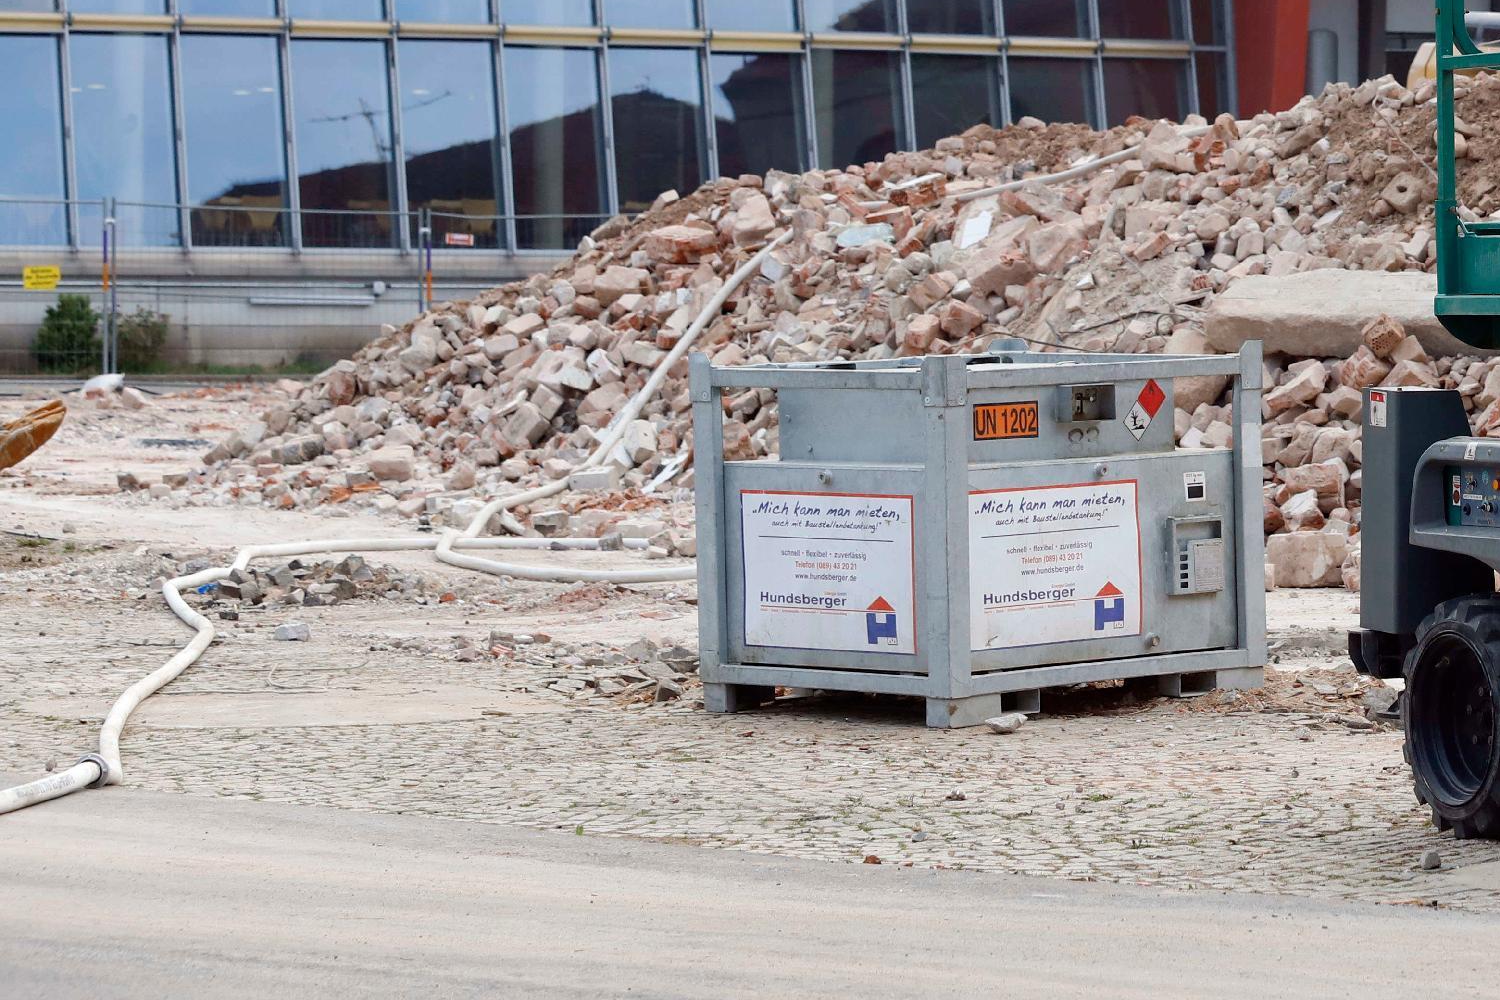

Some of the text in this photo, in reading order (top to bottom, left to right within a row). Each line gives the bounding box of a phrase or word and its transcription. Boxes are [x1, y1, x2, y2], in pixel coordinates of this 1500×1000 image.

[975, 407, 1036, 435] UN 1202
[1019, 497, 1046, 513] kann
[1052, 499, 1076, 509] man
[1081, 493, 1125, 506] mieten,
[794, 501, 821, 516] kann
[826, 507, 850, 516] man
[855, 504, 900, 521] mieten,
[771, 519, 789, 527] auch
[995, 517, 1015, 526] auch
[1017, 516, 1029, 524] mit
[1006, 541, 1093, 555] schnell flexibel zuverlässig
[805, 550, 828, 558] flexibel
[834, 551, 867, 561] zuverlässig
[1021, 552, 1083, 564] Telefon (089) 43 20 21
[795, 561, 815, 569] Telefon
[816, 562, 832, 570] (089)
[834, 562, 840, 570] 43
[1021, 564, 1084, 576] www.hundsberger.de
[795, 573, 857, 582] www.hundsberger.de
[760, 591, 847, 609] Hundsberger
[983, 587, 1075, 605] Hundsberger
